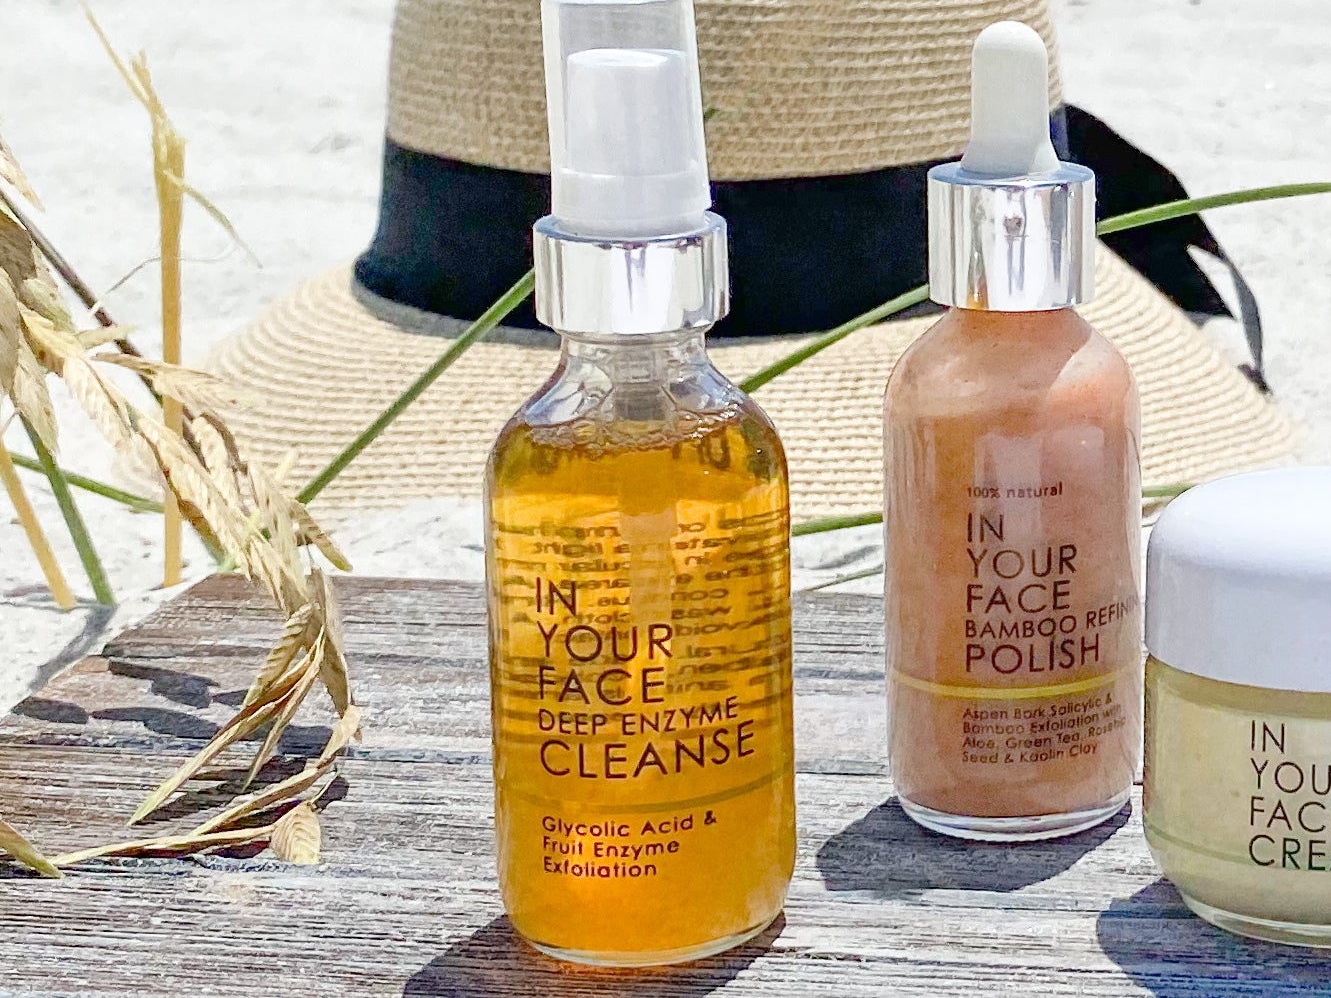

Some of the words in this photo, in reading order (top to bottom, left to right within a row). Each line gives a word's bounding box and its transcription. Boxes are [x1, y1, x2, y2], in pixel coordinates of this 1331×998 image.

[967, 487, 1000, 499] 100%
[1006, 481, 1063, 498] natural
[967, 512, 1004, 542] IN
[966, 544, 1077, 579] YOUR
[536, 577, 577, 615] IN
[966, 580, 1070, 613] FACE
[537, 621, 674, 662] YOUR
[965, 615, 1077, 638] BAMBOO
[966, 633, 1099, 674] POLISH
[538, 666, 665, 705] FACE
[538, 708, 607, 736] DEEP
[621, 696, 738, 736] ENZYME
[963, 708, 1008, 721] Aspen
[1014, 707, 1045, 719] Bark
[963, 722, 1024, 734] Bamboo
[1031, 714, 1099, 733] Exfoliation
[540, 719, 755, 779] CLEANSE
[1005, 737, 1052, 749] Green
[1250, 719, 1285, 754] IN
[962, 751, 999, 763] Seed
[1004, 753, 1014, 763] &
[542, 816, 630, 838] Glycolic
[641, 814, 693, 835] Acid
[703, 810, 717, 825] &
[543, 836, 583, 855] Fruit
[594, 840, 680, 860] Enzyme
[543, 856, 657, 878] Exfoliation
